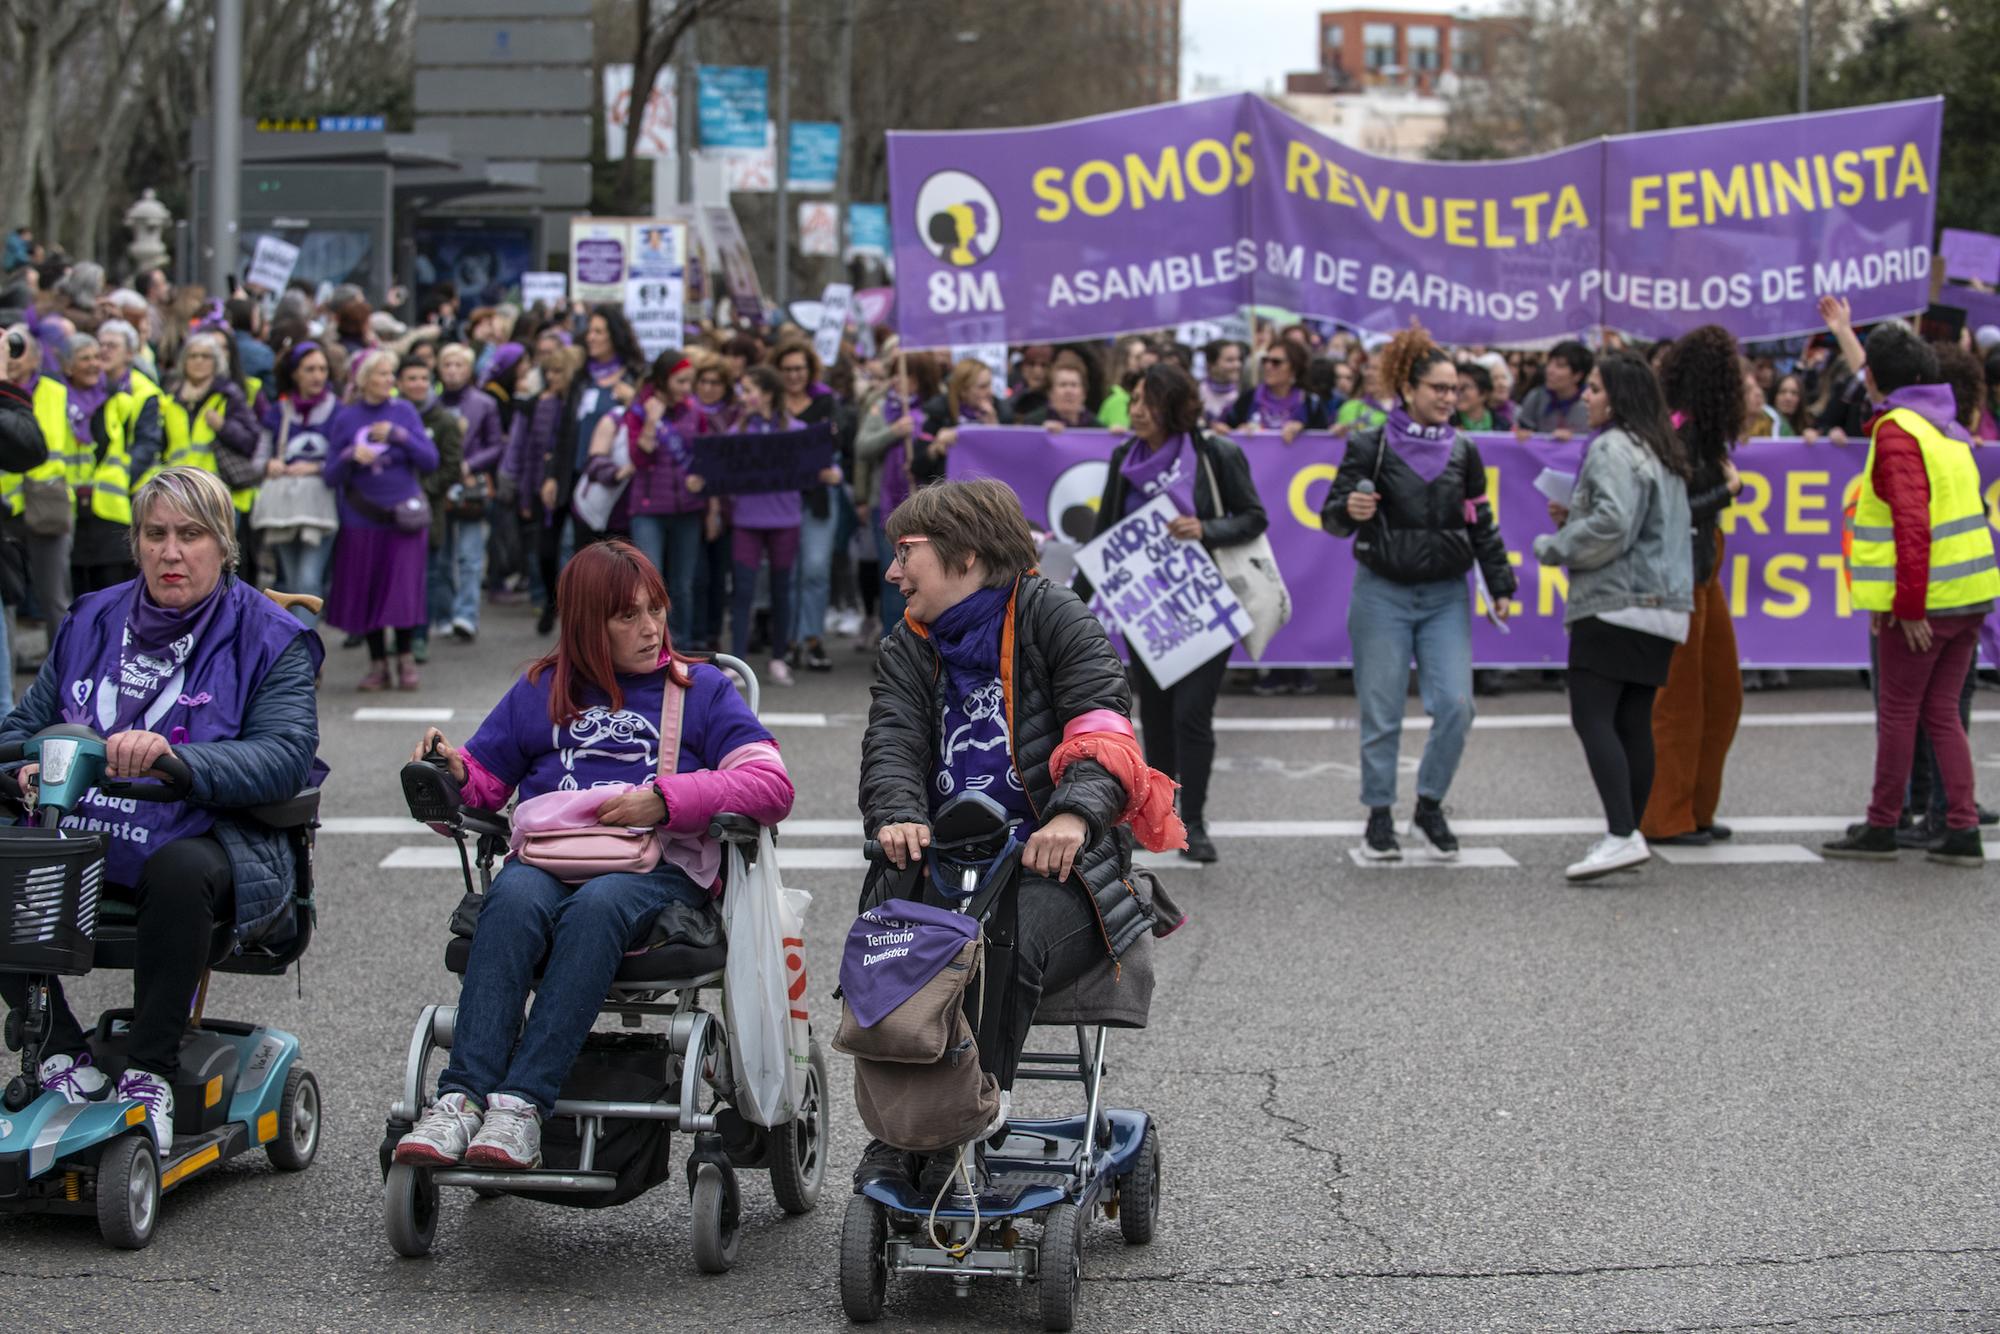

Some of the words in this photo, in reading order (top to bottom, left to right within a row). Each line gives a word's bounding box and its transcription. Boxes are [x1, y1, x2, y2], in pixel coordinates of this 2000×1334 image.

[1032, 131, 1254, 222] SOMOS
[1286, 140, 1588, 248] REVUELTA
[1630, 142, 1929, 229] FEMINISTA
[929, 270, 1005, 314] 8M
[1314, 252, 1361, 294] DE
[1368, 265, 1540, 321] BARRIOS
[1547, 279, 1571, 311] Y
[1580, 269, 1751, 310] PUEBLOS
[1762, 266, 1805, 304] DE
[1813, 246, 1931, 296] MADRID
[1101, 510, 1169, 572] AHORA
[1146, 533, 1182, 563] QUE
[1113, 545, 1208, 624] NUNCA
[1137, 566, 1223, 641] JUNTAS
[1149, 614, 1205, 661] SOMOS
[865, 930, 914, 947] Territorio
[44, 1063, 57, 1073] FILA
